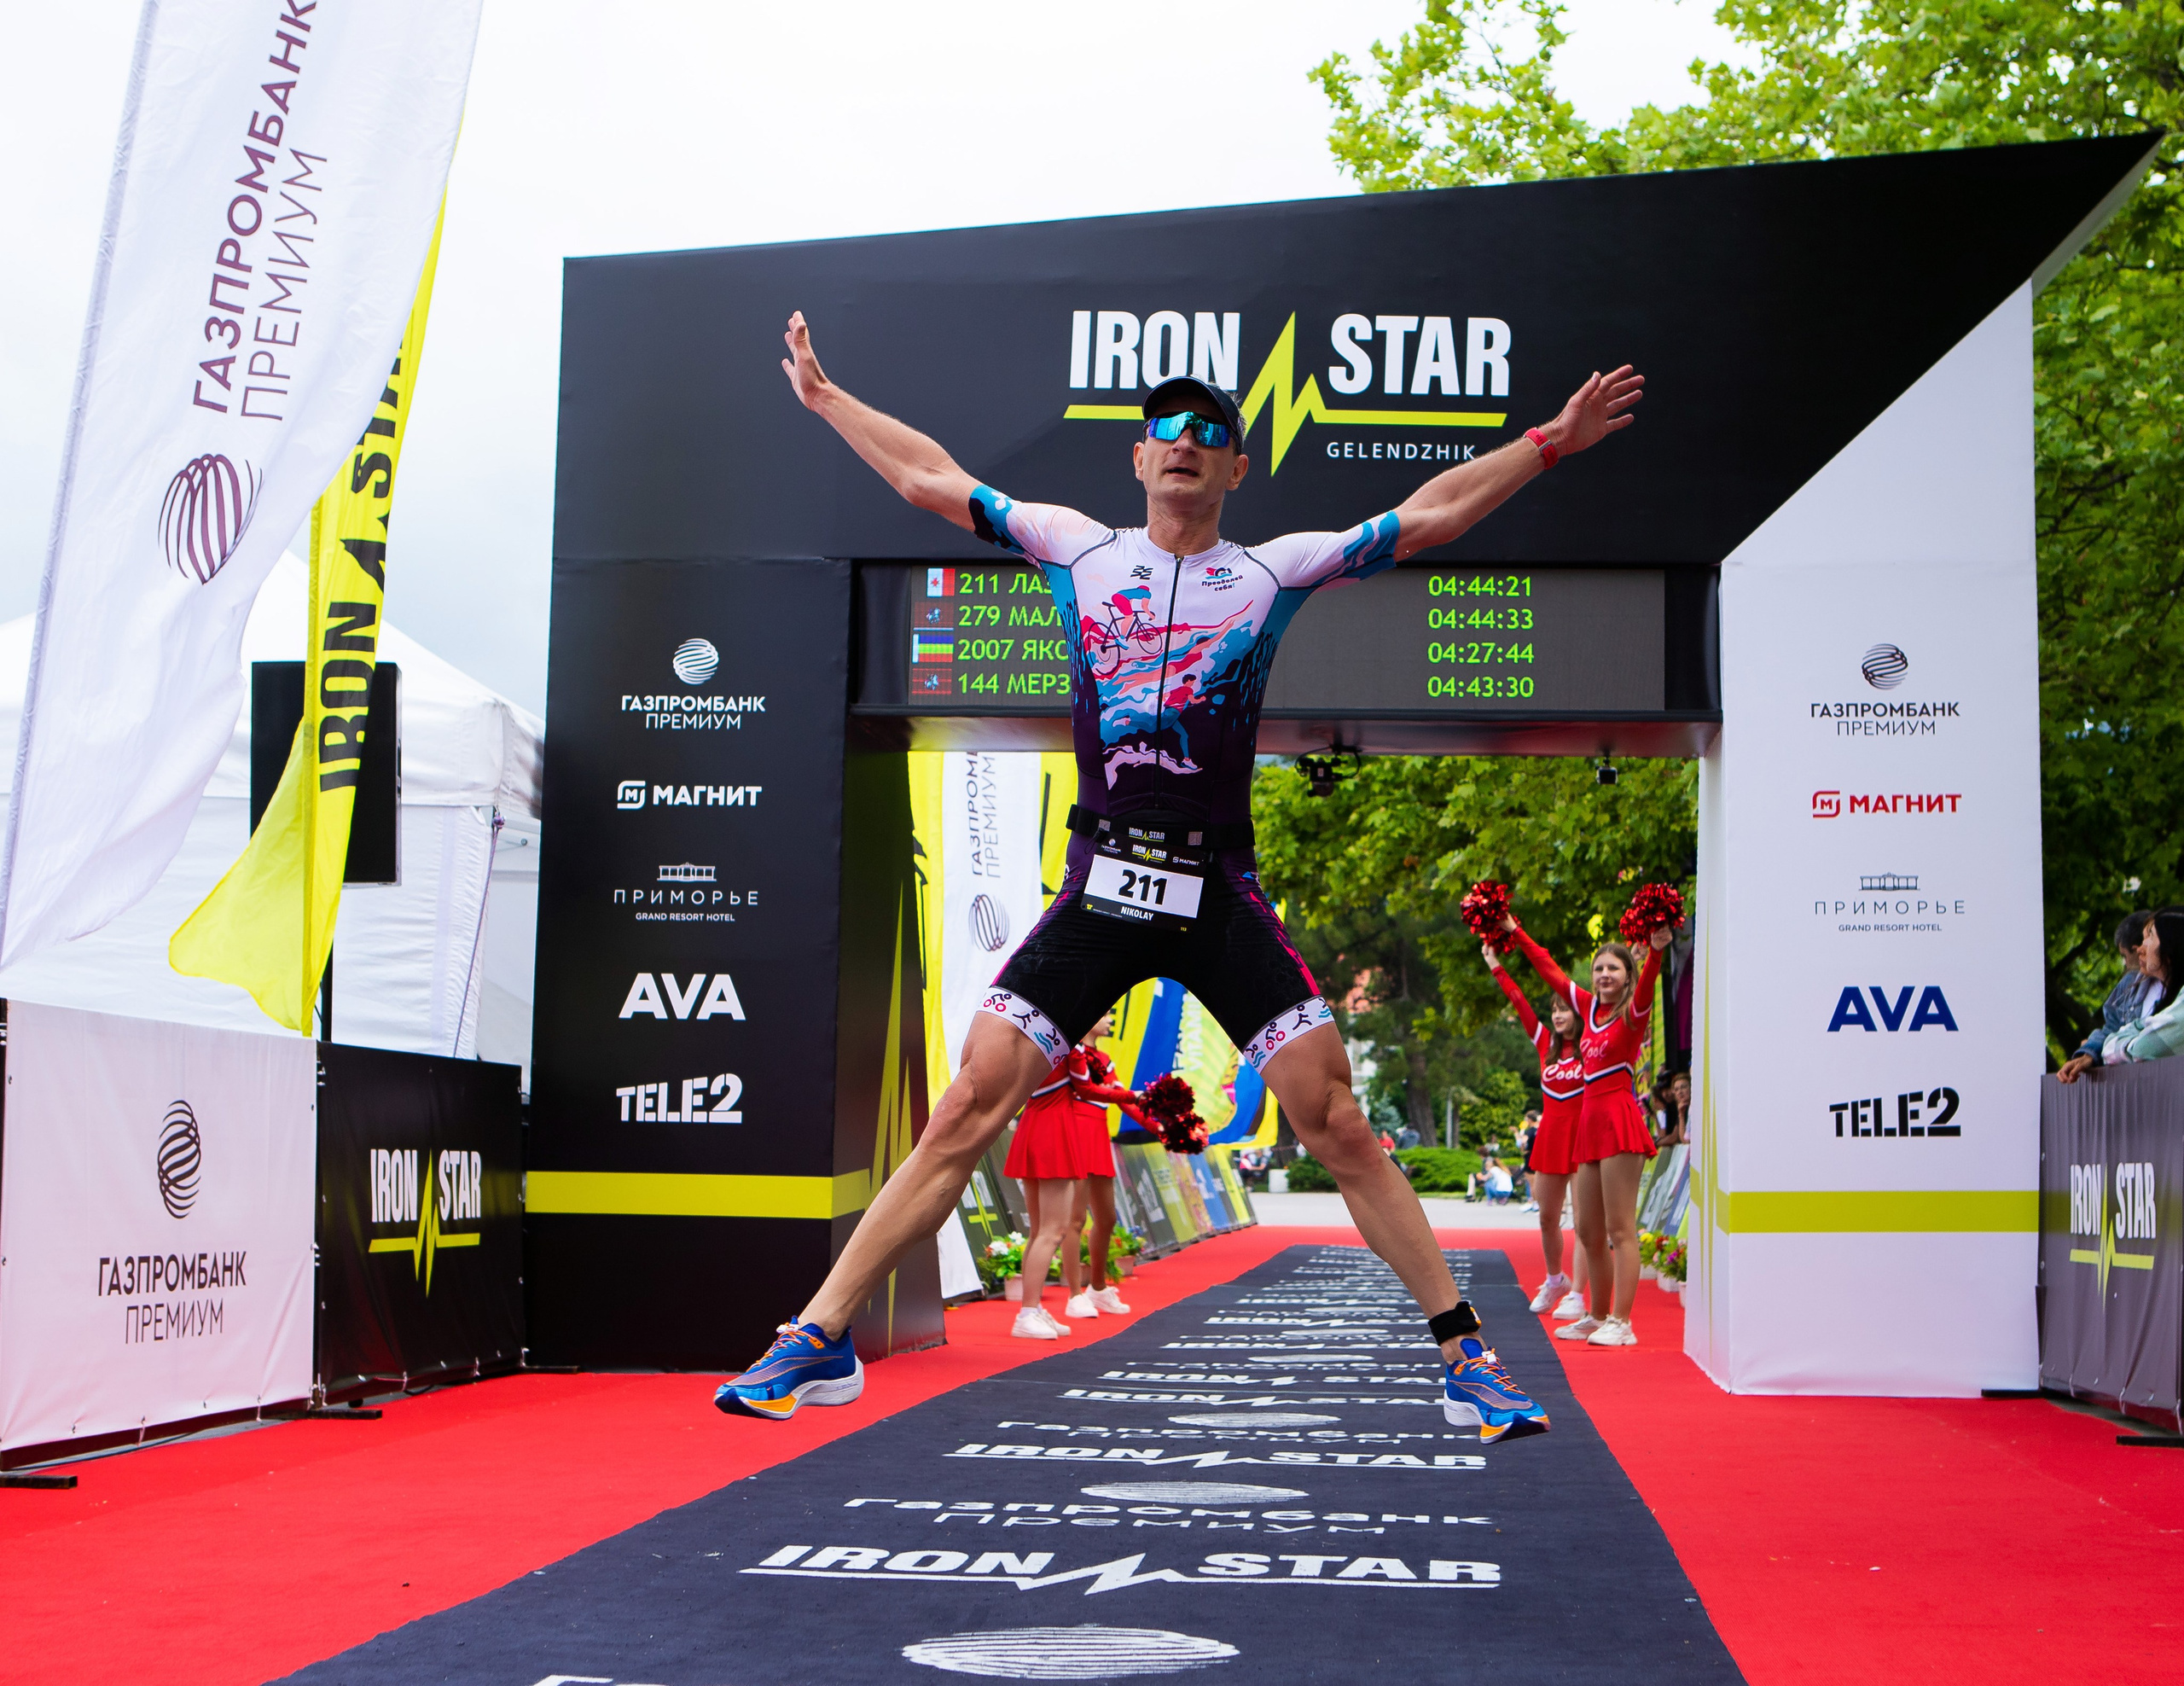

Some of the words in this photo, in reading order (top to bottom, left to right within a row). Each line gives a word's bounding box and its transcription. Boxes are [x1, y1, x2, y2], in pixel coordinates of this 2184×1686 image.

[193, 0, 317, 414] ГАЗПРОМБАНК
[240, 148, 328, 422] ПРЕМИУМ
[1069, 310, 1240, 391] IRON
[1327, 313, 1512, 397] STAR
[1327, 441, 1475, 461] GELENDZHIK
[959, 573, 999, 594] 211
[1427, 575, 1532, 596] 04:44:21
[958, 605, 1002, 627] 279
[1008, 605, 1062, 627] МАЛ
[1427, 608, 1534, 630] 04:44:33
[957, 639, 1014, 660] 2007
[1427, 642, 1535, 664] 04:27:44
[957, 673, 999, 695] 144
[1427, 676, 1535, 698] 04:43:30
[319, 601, 377, 793] IRON
[621, 695, 766, 712] ГАЗПРОМБАНК
[1810, 701, 1960, 718] ГАЗПРОМБАНК
[646, 712, 741, 730] ПРЕМИУМ
[1837, 720, 1936, 736] ПРЕМИУМ
[653, 785, 763, 806] МАГНИТ
[1849, 794, 1962, 813] МАГНИТ
[982, 755, 1001, 879] ПРЕМИУМ
[1129, 827, 1143, 837] IRON
[1148, 830, 1165, 840] STAR
[1132, 844, 1147, 854] IRON
[1151, 848, 1167, 859] STAR
[613, 889, 758, 905] ПРИМОРЬЕ
[1118, 869, 1167, 905] 211
[636, 912, 667, 921] GRAND
[669, 912, 704, 921] RESORT
[706, 913, 735, 921] HOTEL
[1120, 906, 1154, 921] NIKOLAY
[1815, 900, 1966, 916] ПРИМОРЬЕ
[1838, 923, 1872, 933] GRAND
[1873, 923, 1910, 932] RESORT
[1912, 923, 1943, 932] HOTEL
[619, 973, 746, 1020] AVA
[1827, 985, 1959, 1032] AVA
[1542, 1063, 1583, 1082] Cool
[616, 1073, 743, 1124] TELE2
[1829, 1086, 1961, 1137] TELE2
[370, 1148, 418, 1223] IRON
[439, 1150, 482, 1221] STAR
[2071, 1164, 2101, 1236] IRON
[2116, 1162, 2156, 1239] STAR
[97, 1250, 247, 1297] ГАЗПРОМБАНК
[125, 1298, 224, 1345] ПРЕМИУМ
[1102, 1370, 1250, 1381] IRON
[1062, 1389, 1225, 1402] IRON
[955, 1444, 1165, 1459] IRON
[1269, 1451, 1487, 1467] STAR
[759, 1544, 1055, 1575] IRON
[1198, 1552, 1502, 1581] STAR
